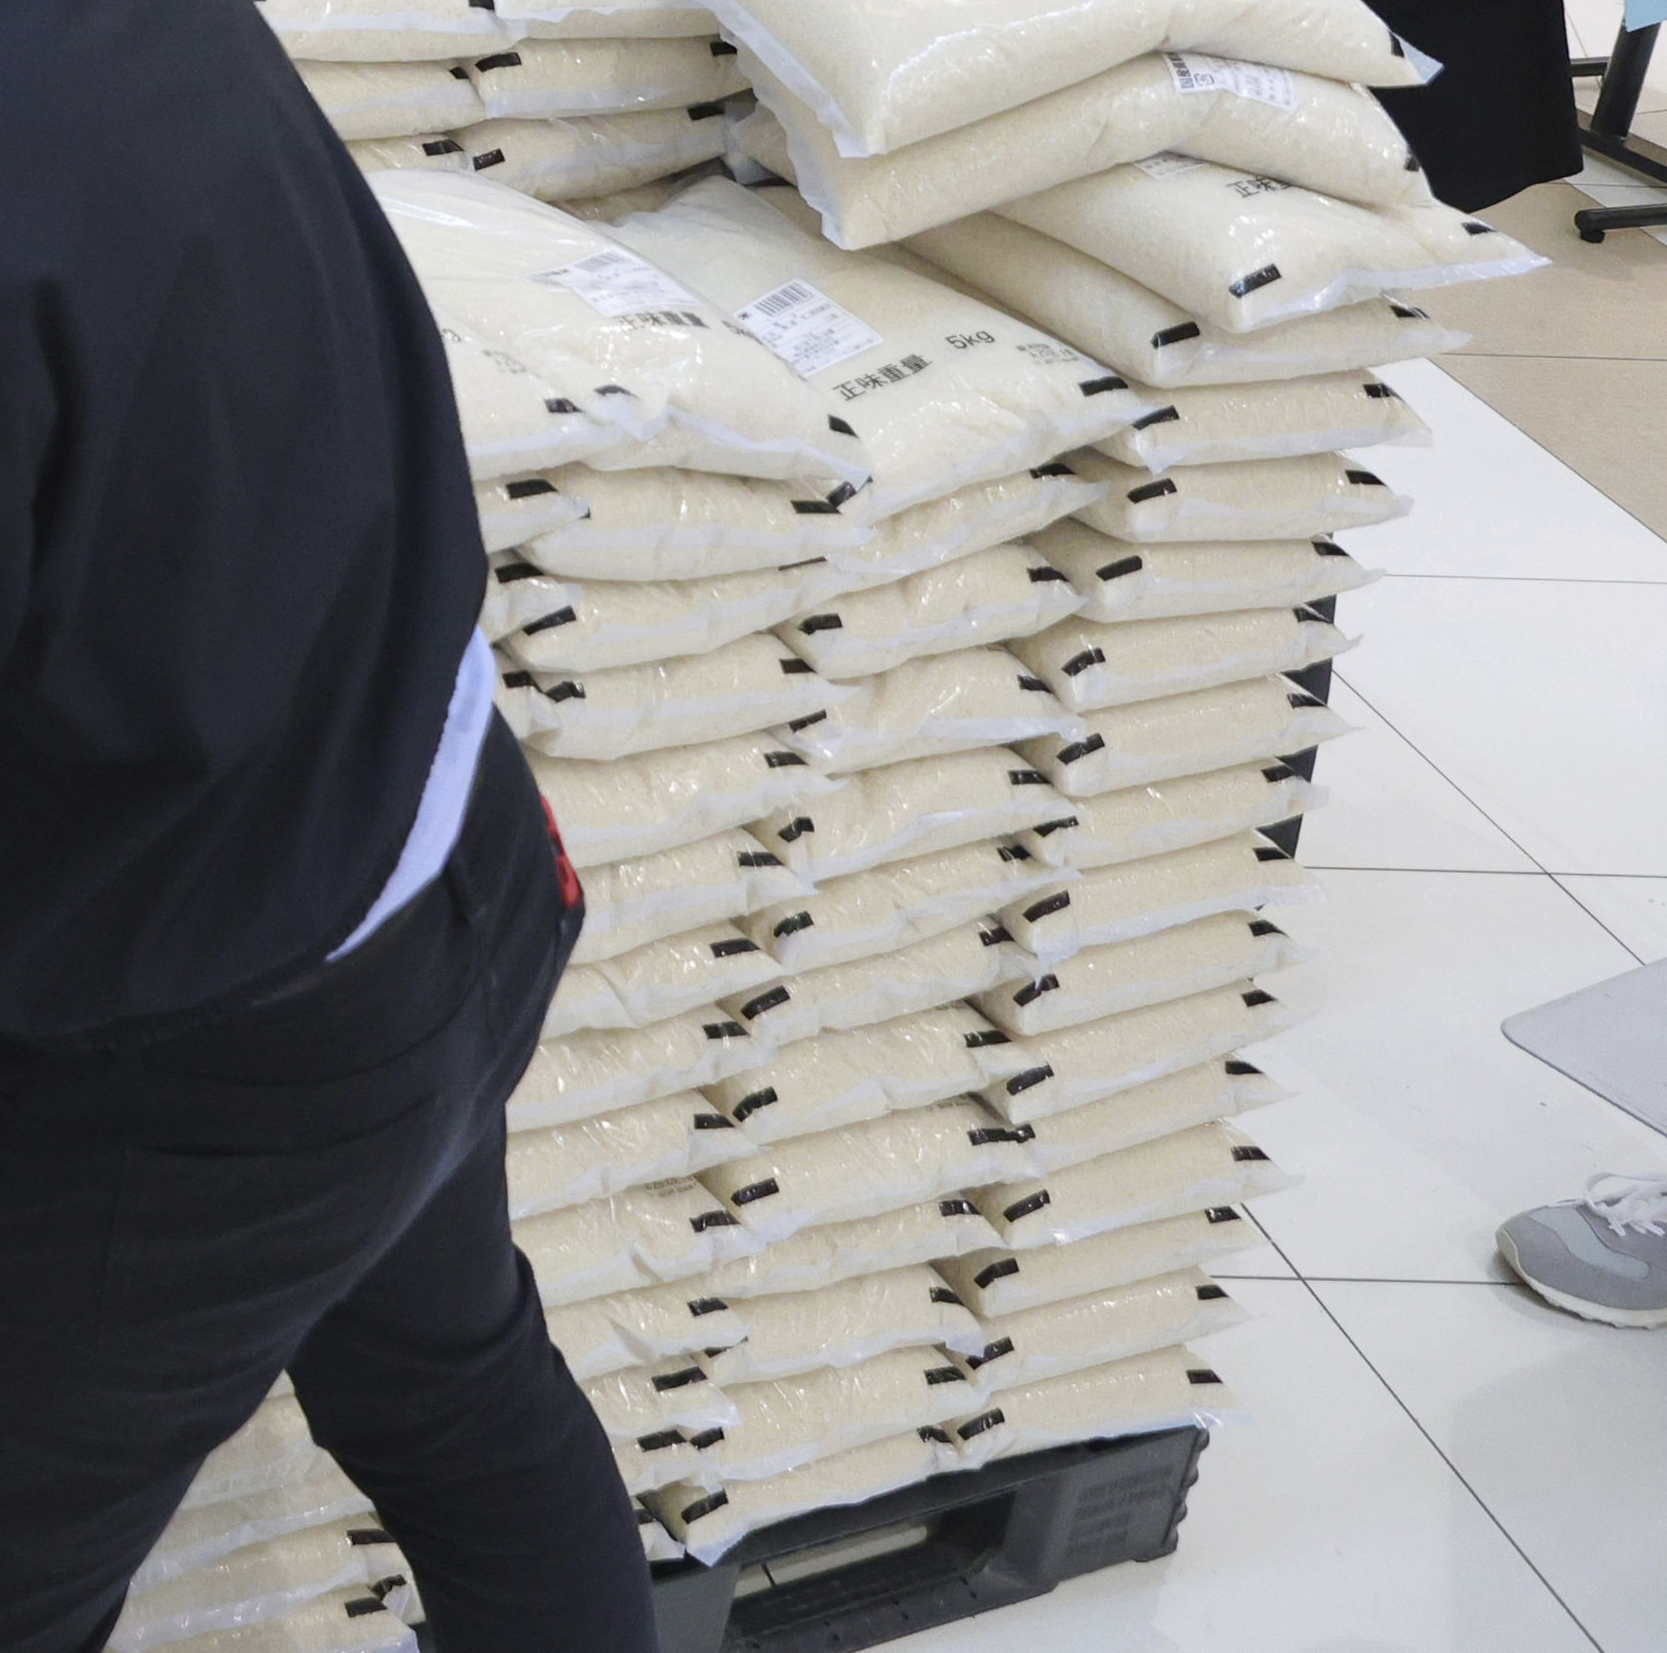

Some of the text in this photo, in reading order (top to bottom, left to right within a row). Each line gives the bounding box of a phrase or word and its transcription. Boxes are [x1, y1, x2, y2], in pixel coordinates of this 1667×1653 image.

[832, 328, 996, 402] 正味重量 5kg
